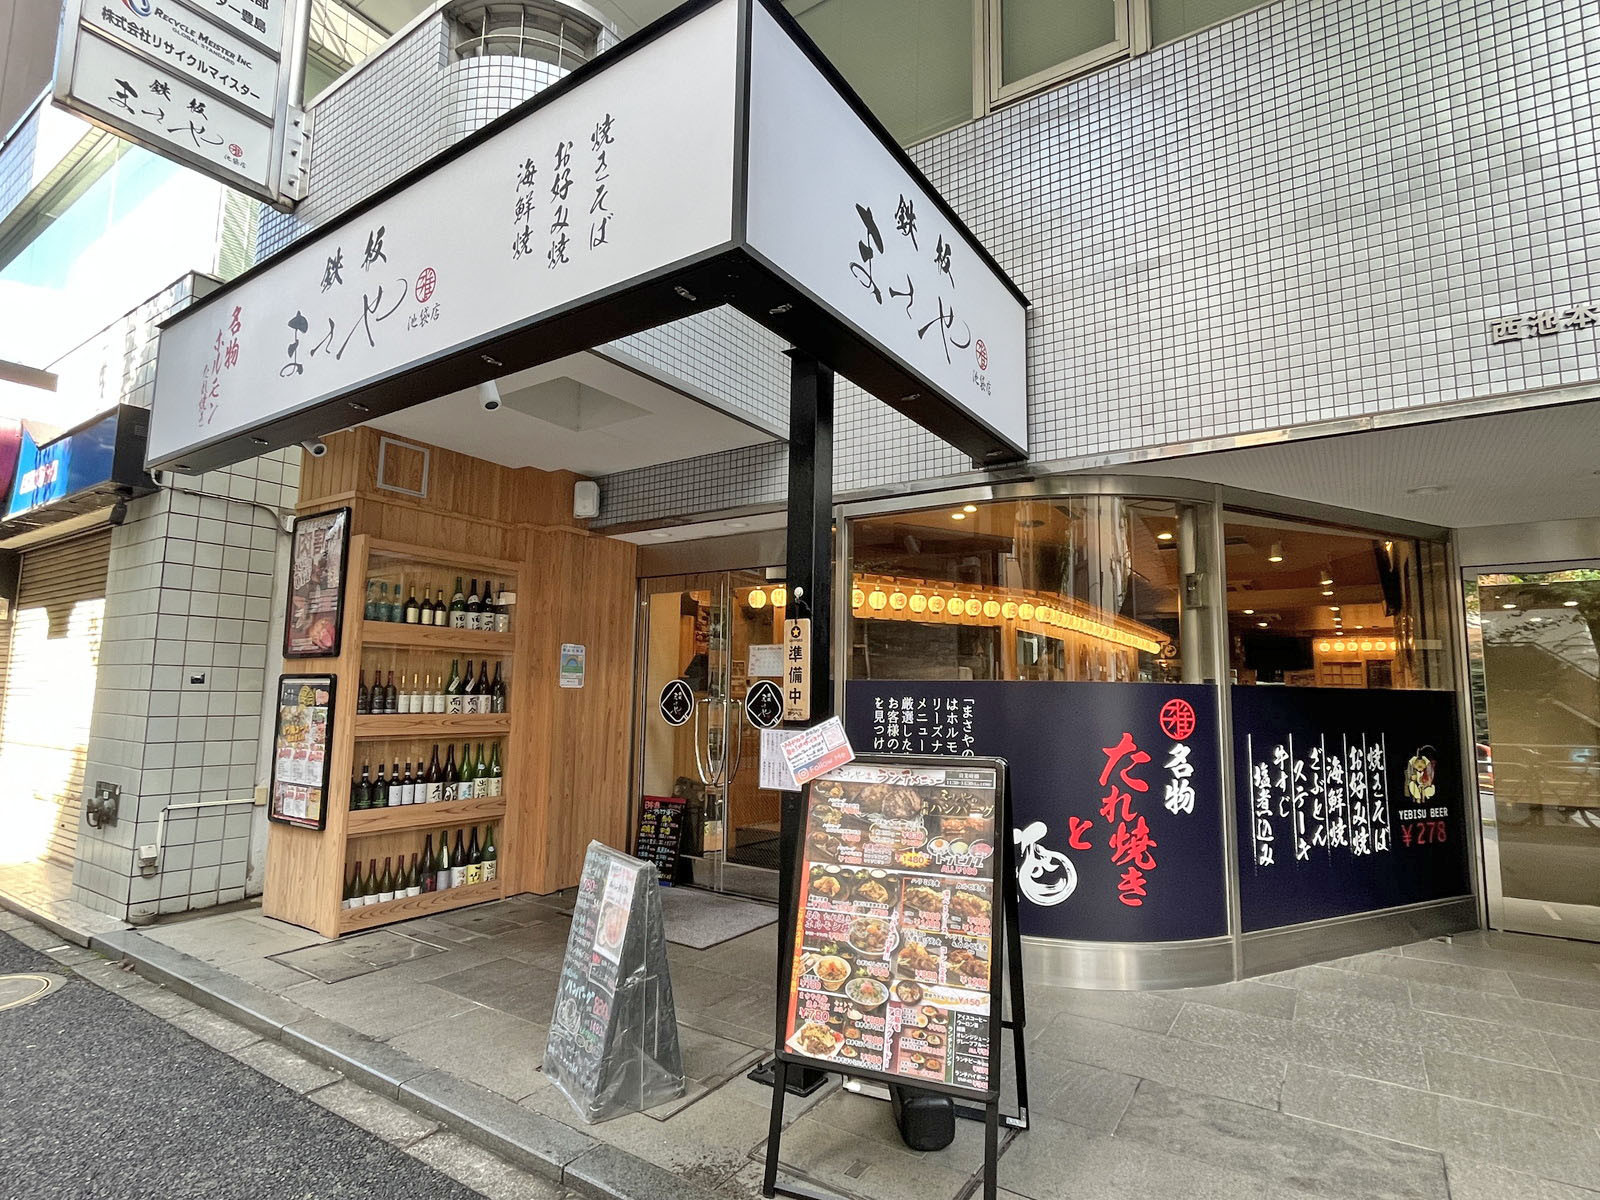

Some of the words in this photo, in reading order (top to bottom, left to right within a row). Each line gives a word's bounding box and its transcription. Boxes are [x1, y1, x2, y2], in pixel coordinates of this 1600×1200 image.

[101, 7, 261, 100] 株式会社リサイクルマイスター
[154, 7, 196, 37] RECYCLE
[198, 32, 236, 60] MEISTER
[172, 27, 199, 47] GLOBAL
[201, 44, 236, 66] STANDARD
[512, 158, 538, 260] 海鮮焼
[547, 141, 574, 270] お好み焼
[590, 113, 616, 251] 焼きそば
[320, 225, 388, 294] 鉄板
[849, 202, 971, 365] まさや
[223, 305, 242, 370] 名物
[279, 278, 408, 379] まさや
[407, 302, 441, 332] 池袋店
[1490, 304, 1598, 345] 西池本
[207, 328, 225, 425] ホルモン
[788, 645, 803, 705] 準備中
[873, 696, 885, 753] を見つけ
[887, 696, 899, 754] お客様の
[901, 696, 914, 754] 厳選した
[916, 697, 928, 752] メニュー
[931, 697, 944, 755] リーズナ
[946, 697, 959, 753] はホルモ
[962, 697, 975, 757] 「まさやの
[1163, 742, 1196, 815] 名物
[1273, 744, 1290, 818] 牛すじ
[1293, 760, 1312, 861] ステーキ
[1310, 747, 1327, 847] ざぶとん
[1327, 755, 1348, 848] 海鮮焼
[1349, 746, 1371, 856] お好み焼
[1367, 743, 1389, 852] 焼きそば
[1068, 816, 1093, 850] と
[1099, 732, 1157, 907] たれ焼き
[1254, 762, 1275, 867] 塩煮込み
[1399, 809, 1427, 820] YEBISU
[1430, 807, 1449, 818] BEER
[1401, 821, 1447, 847] ¥278
